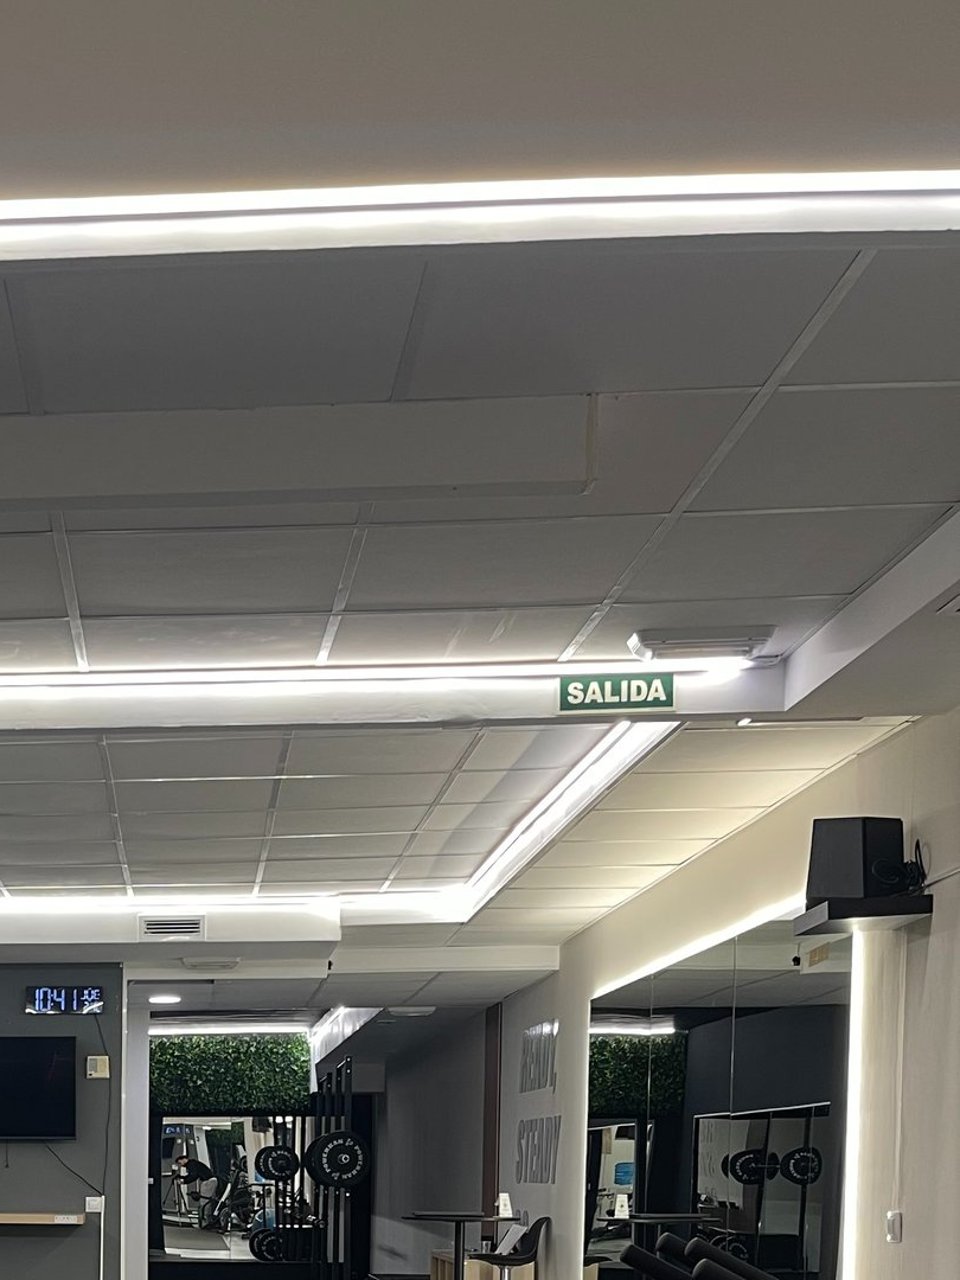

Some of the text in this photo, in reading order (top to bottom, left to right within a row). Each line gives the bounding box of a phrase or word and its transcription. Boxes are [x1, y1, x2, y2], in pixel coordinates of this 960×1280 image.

[567, 679, 667, 704] SALIDA
[35, 987, 78, 1012] 10:41
[515, 1114, 562, 1185] STEADY
